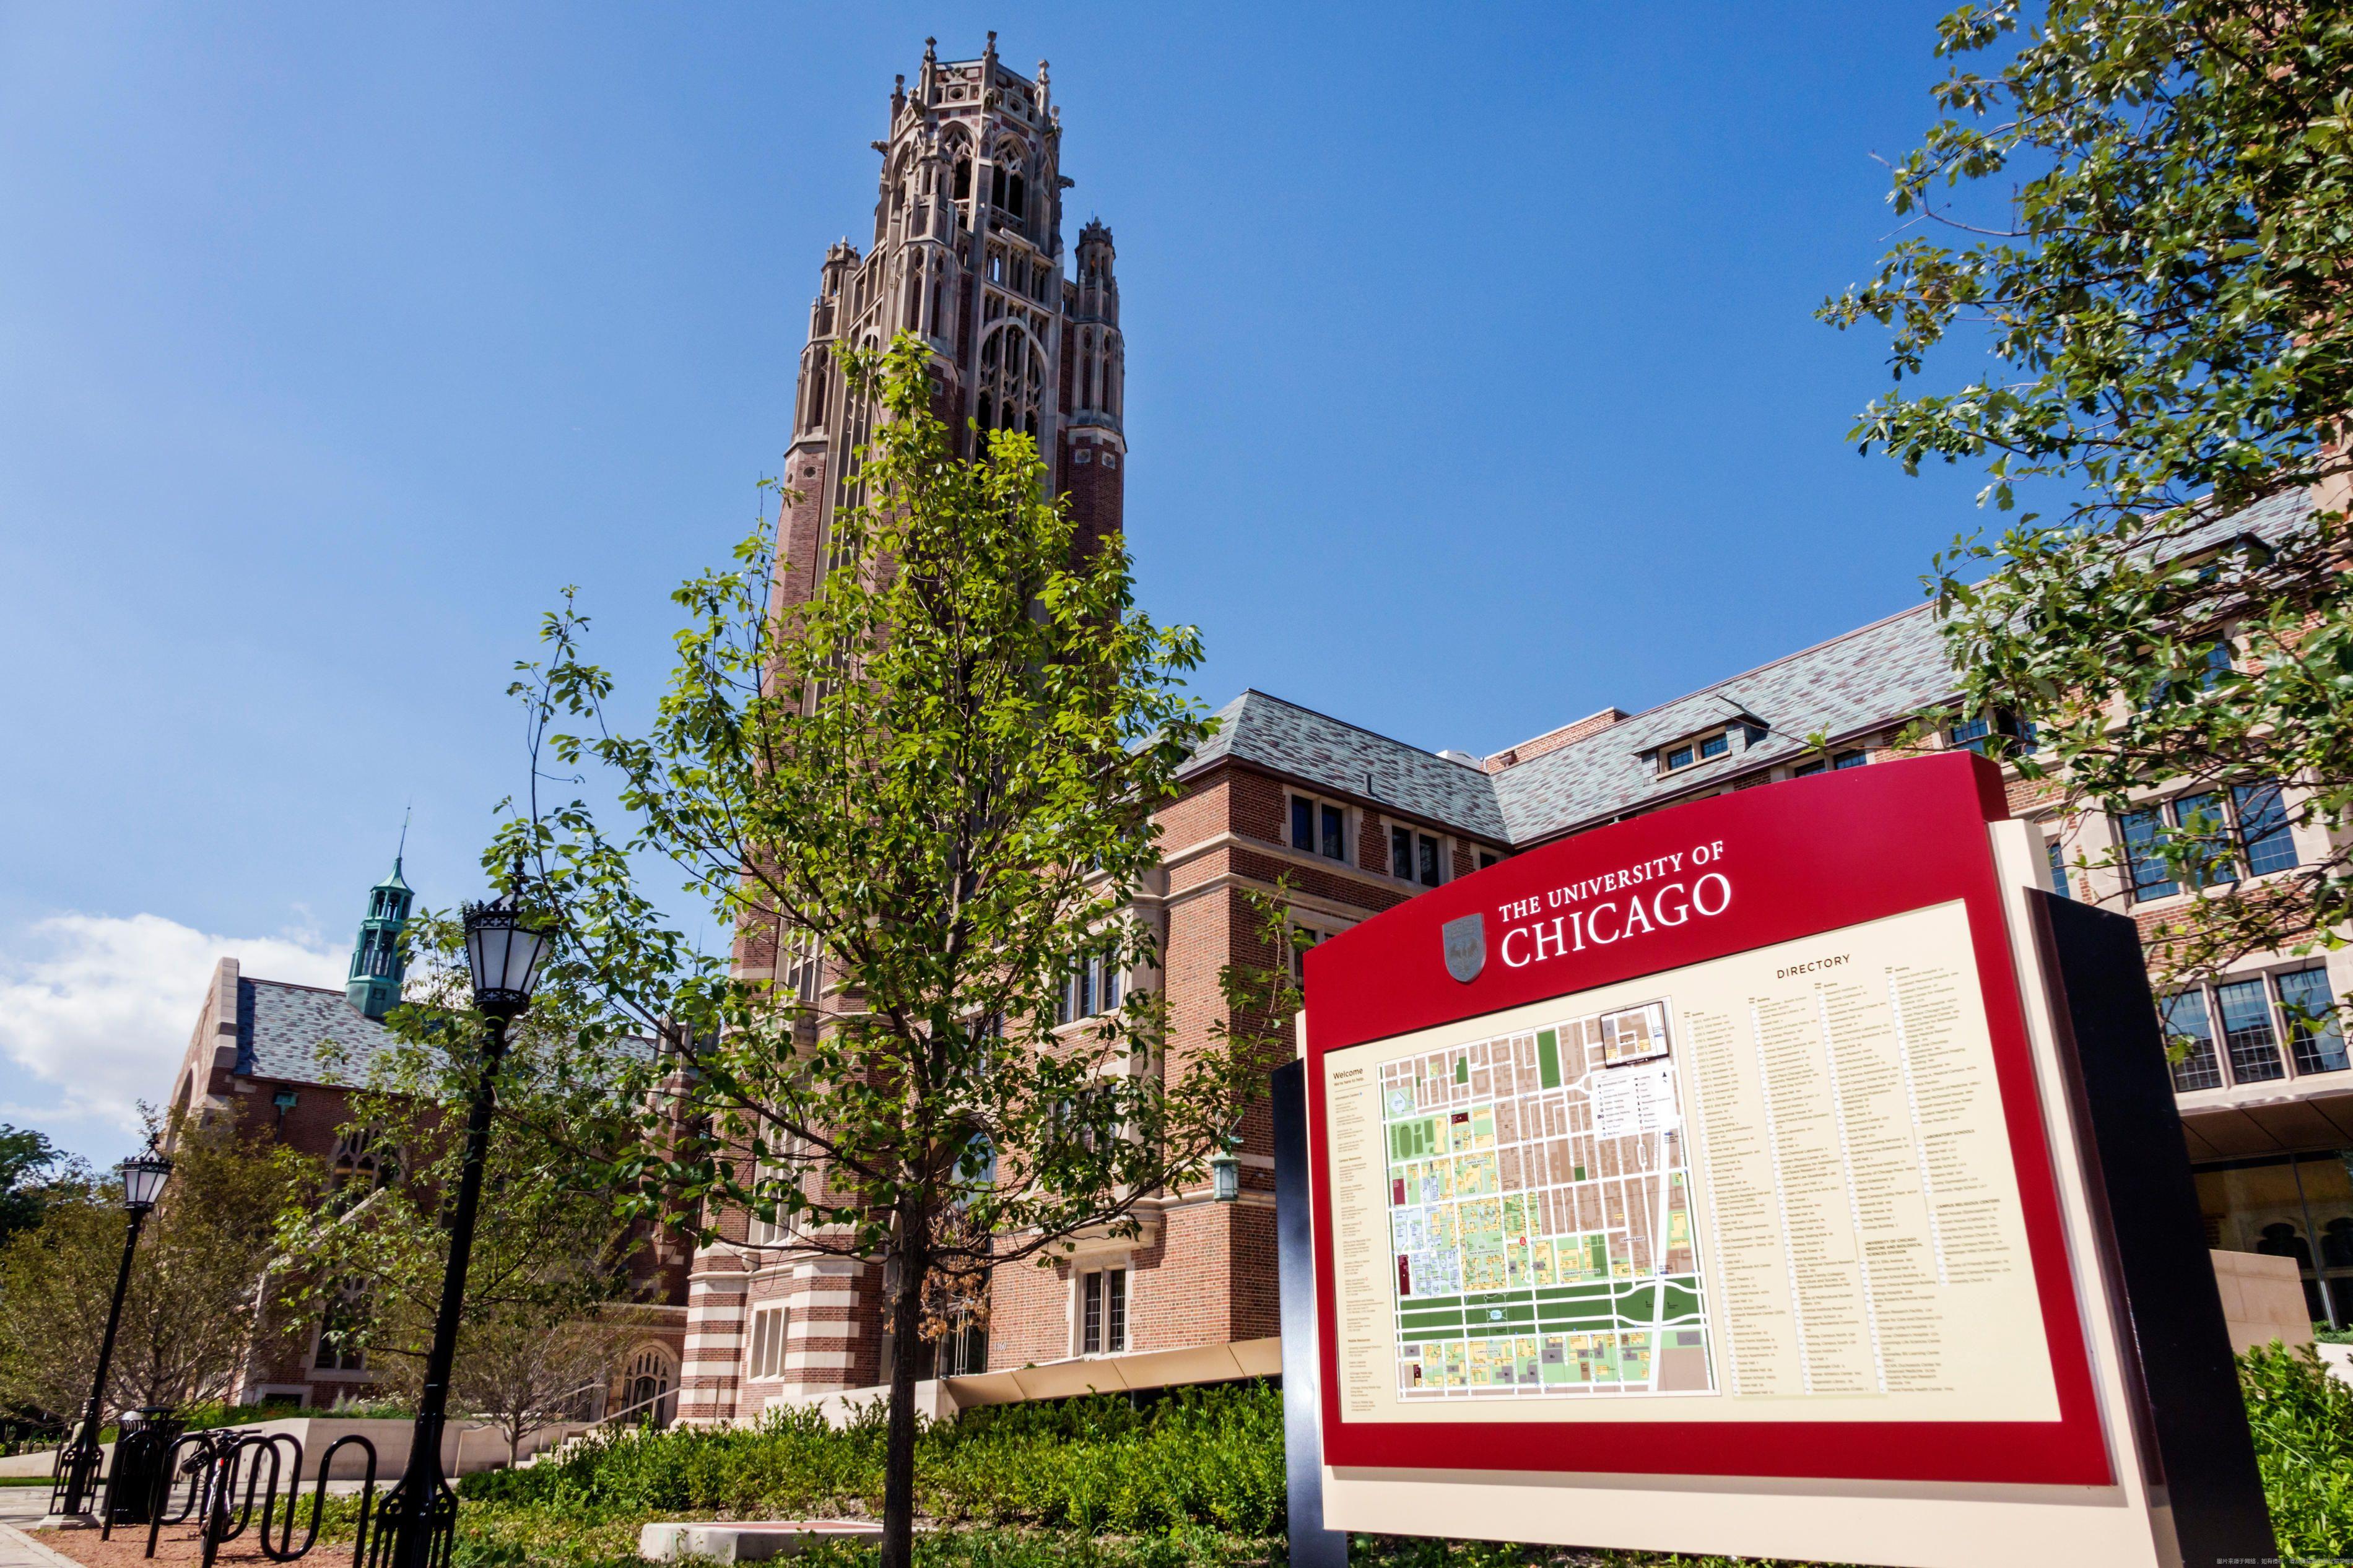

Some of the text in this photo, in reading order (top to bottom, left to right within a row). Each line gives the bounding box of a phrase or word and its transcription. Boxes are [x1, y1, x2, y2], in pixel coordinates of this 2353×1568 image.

[1498, 840, 1725, 922] THE UNIVERSITY OF
[1501, 872, 1732, 968] CHICAGO
[1777, 954, 1850, 979] DIRECTORY
[1333, 1068, 1363, 1080] Welcome
